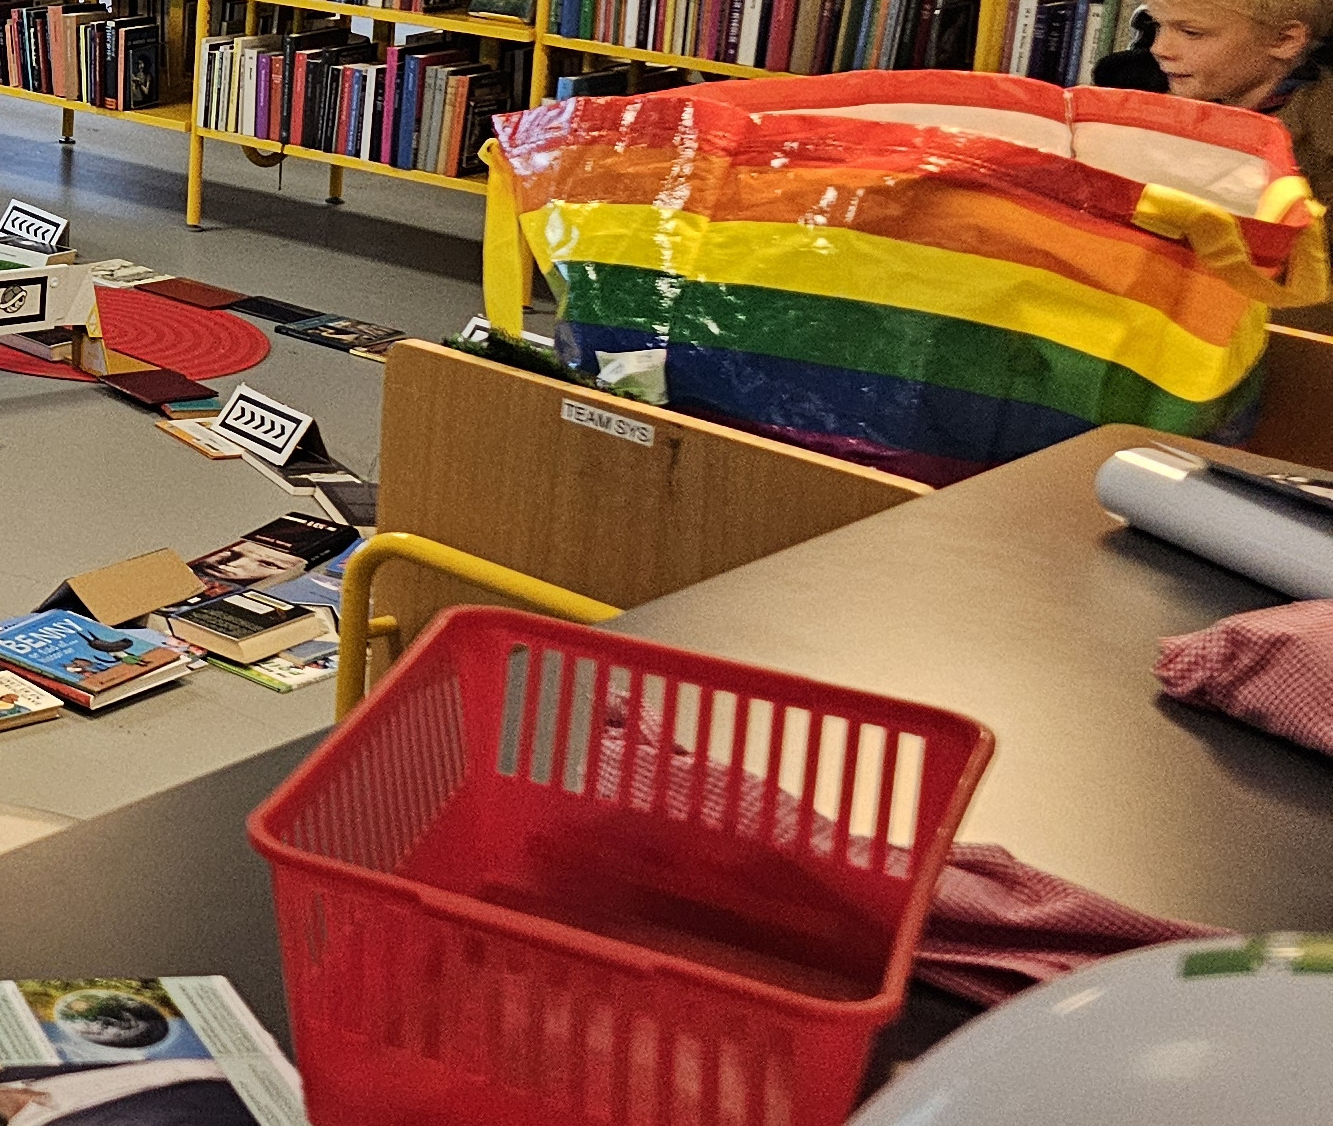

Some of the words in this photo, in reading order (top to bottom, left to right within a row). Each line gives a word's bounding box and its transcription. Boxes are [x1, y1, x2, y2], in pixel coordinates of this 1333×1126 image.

[564, 402, 612, 430] TEAM
[615, 419, 650, 443] SYS
[1, 618, 84, 654] BENNY
